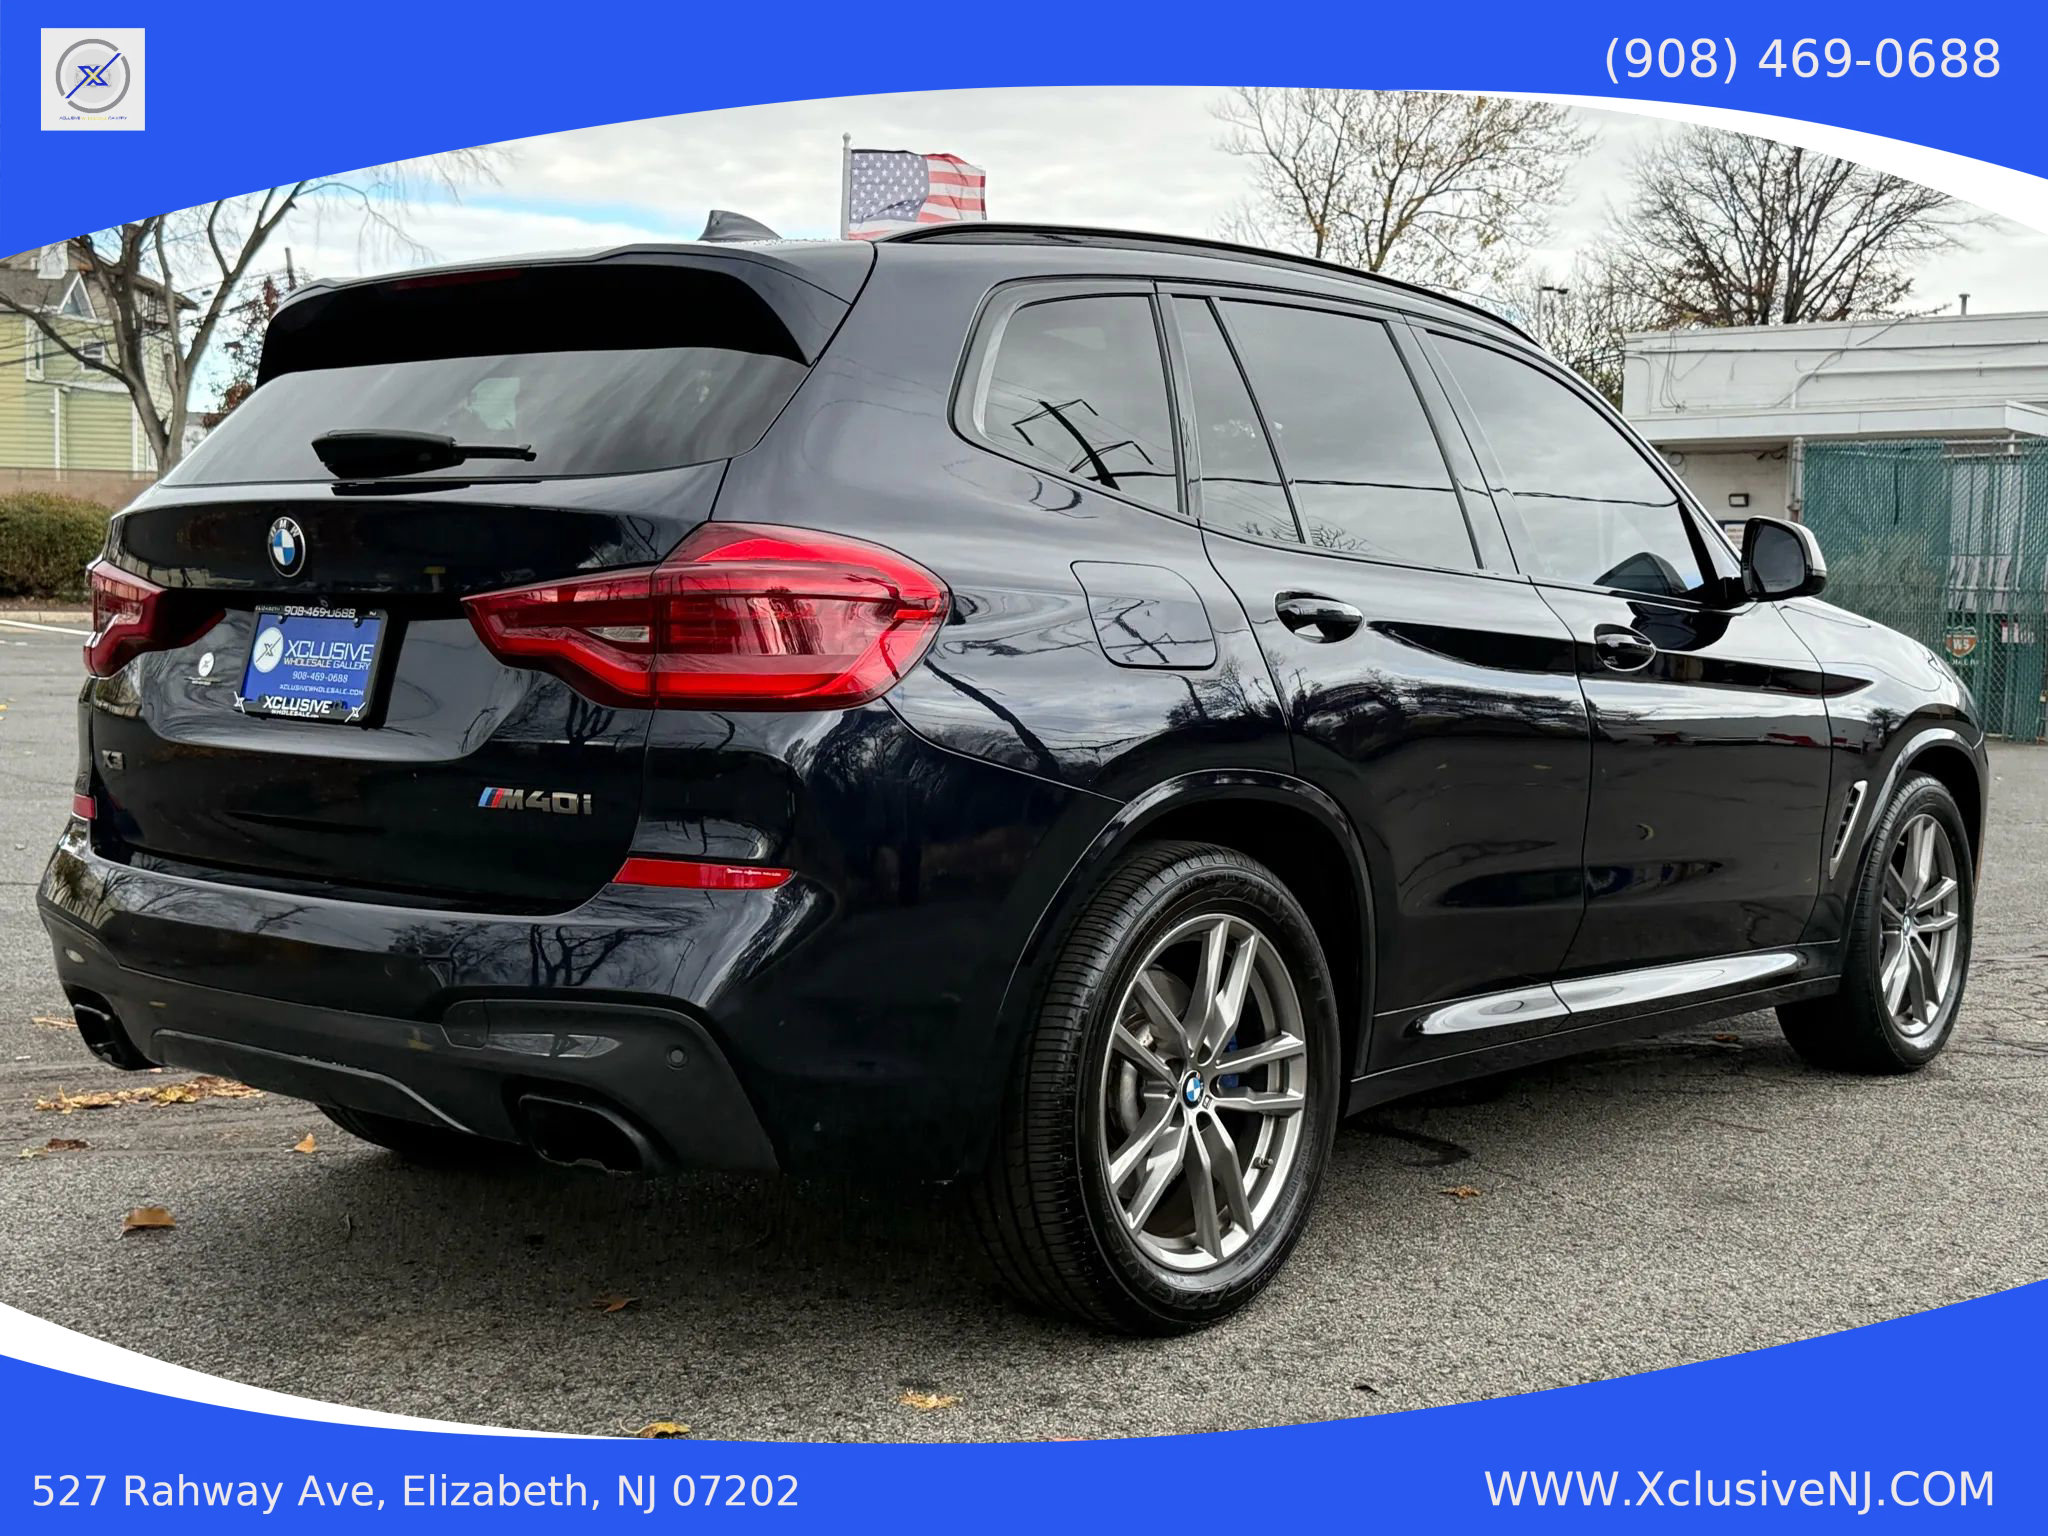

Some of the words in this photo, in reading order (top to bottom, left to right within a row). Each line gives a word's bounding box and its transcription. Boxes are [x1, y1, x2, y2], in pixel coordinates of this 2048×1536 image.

[285, 640, 375, 662] XCLUSIVE
[284, 657, 332, 669] WHOLESALE
[333, 660, 371, 671] GALLERY
[292, 671, 349, 683] 908-469-0688
[263, 695, 333, 714] XCLUSIVE
